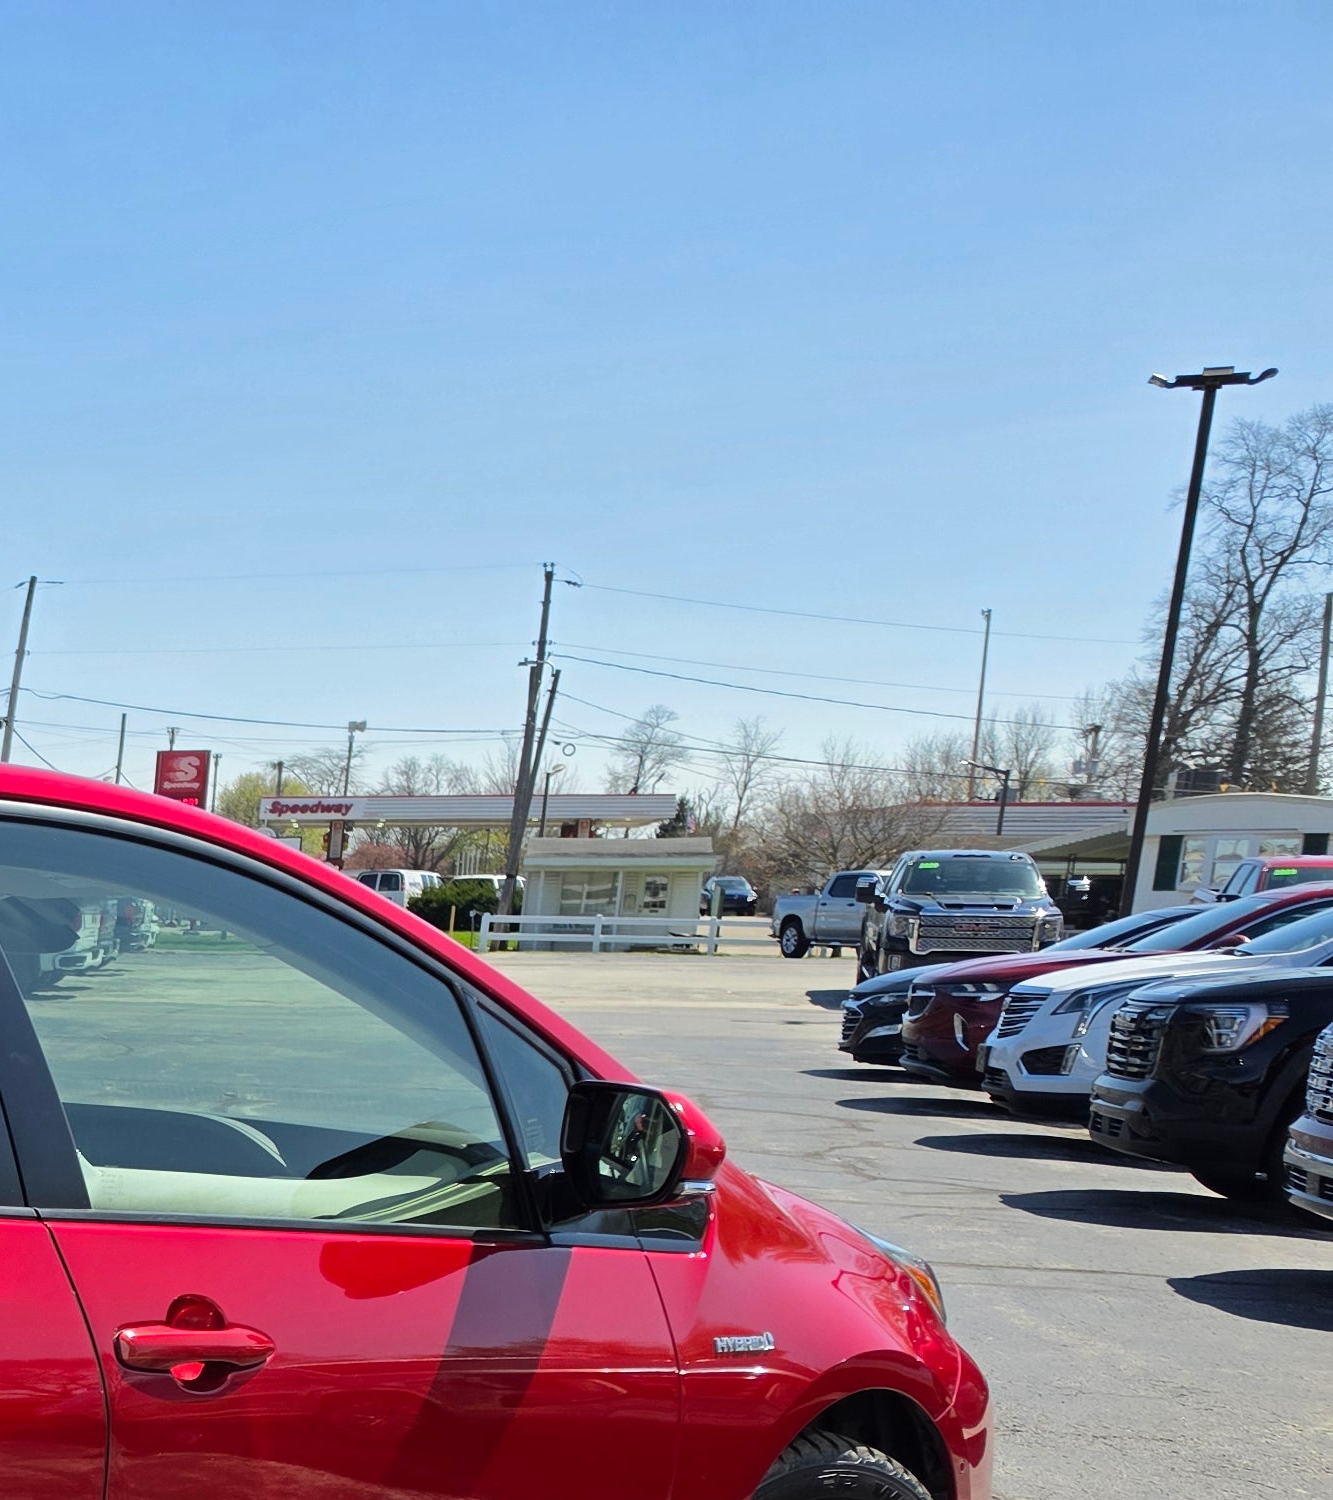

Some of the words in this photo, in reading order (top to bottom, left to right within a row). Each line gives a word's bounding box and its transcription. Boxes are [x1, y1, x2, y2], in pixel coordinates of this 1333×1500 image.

[163, 781, 201, 790] Speedway
[269, 800, 354, 817] Speedway
[713, 1335, 765, 1353] HYBRID
